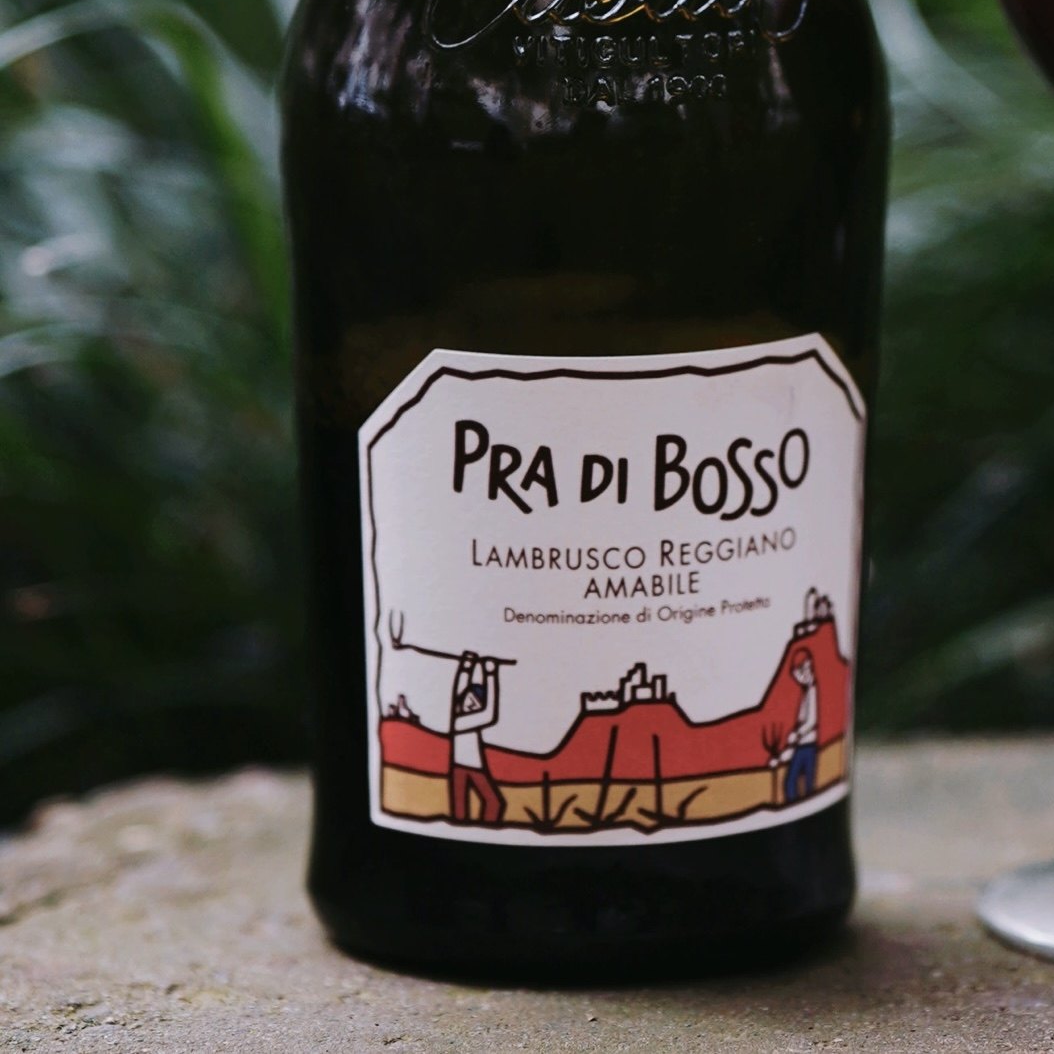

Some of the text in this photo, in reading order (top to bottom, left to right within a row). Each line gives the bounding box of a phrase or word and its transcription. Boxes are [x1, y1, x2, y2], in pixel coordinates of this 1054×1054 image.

[453, 419, 811, 522] PRA DI BOSSO
[471, 527, 797, 572] LAMBRUSCO REGGIANO
[583, 572, 700, 599] AMABILE
[504, 605, 631, 626] Denominazione
[636, 606, 652, 623] di
[657, 602, 716, 626] Origine
